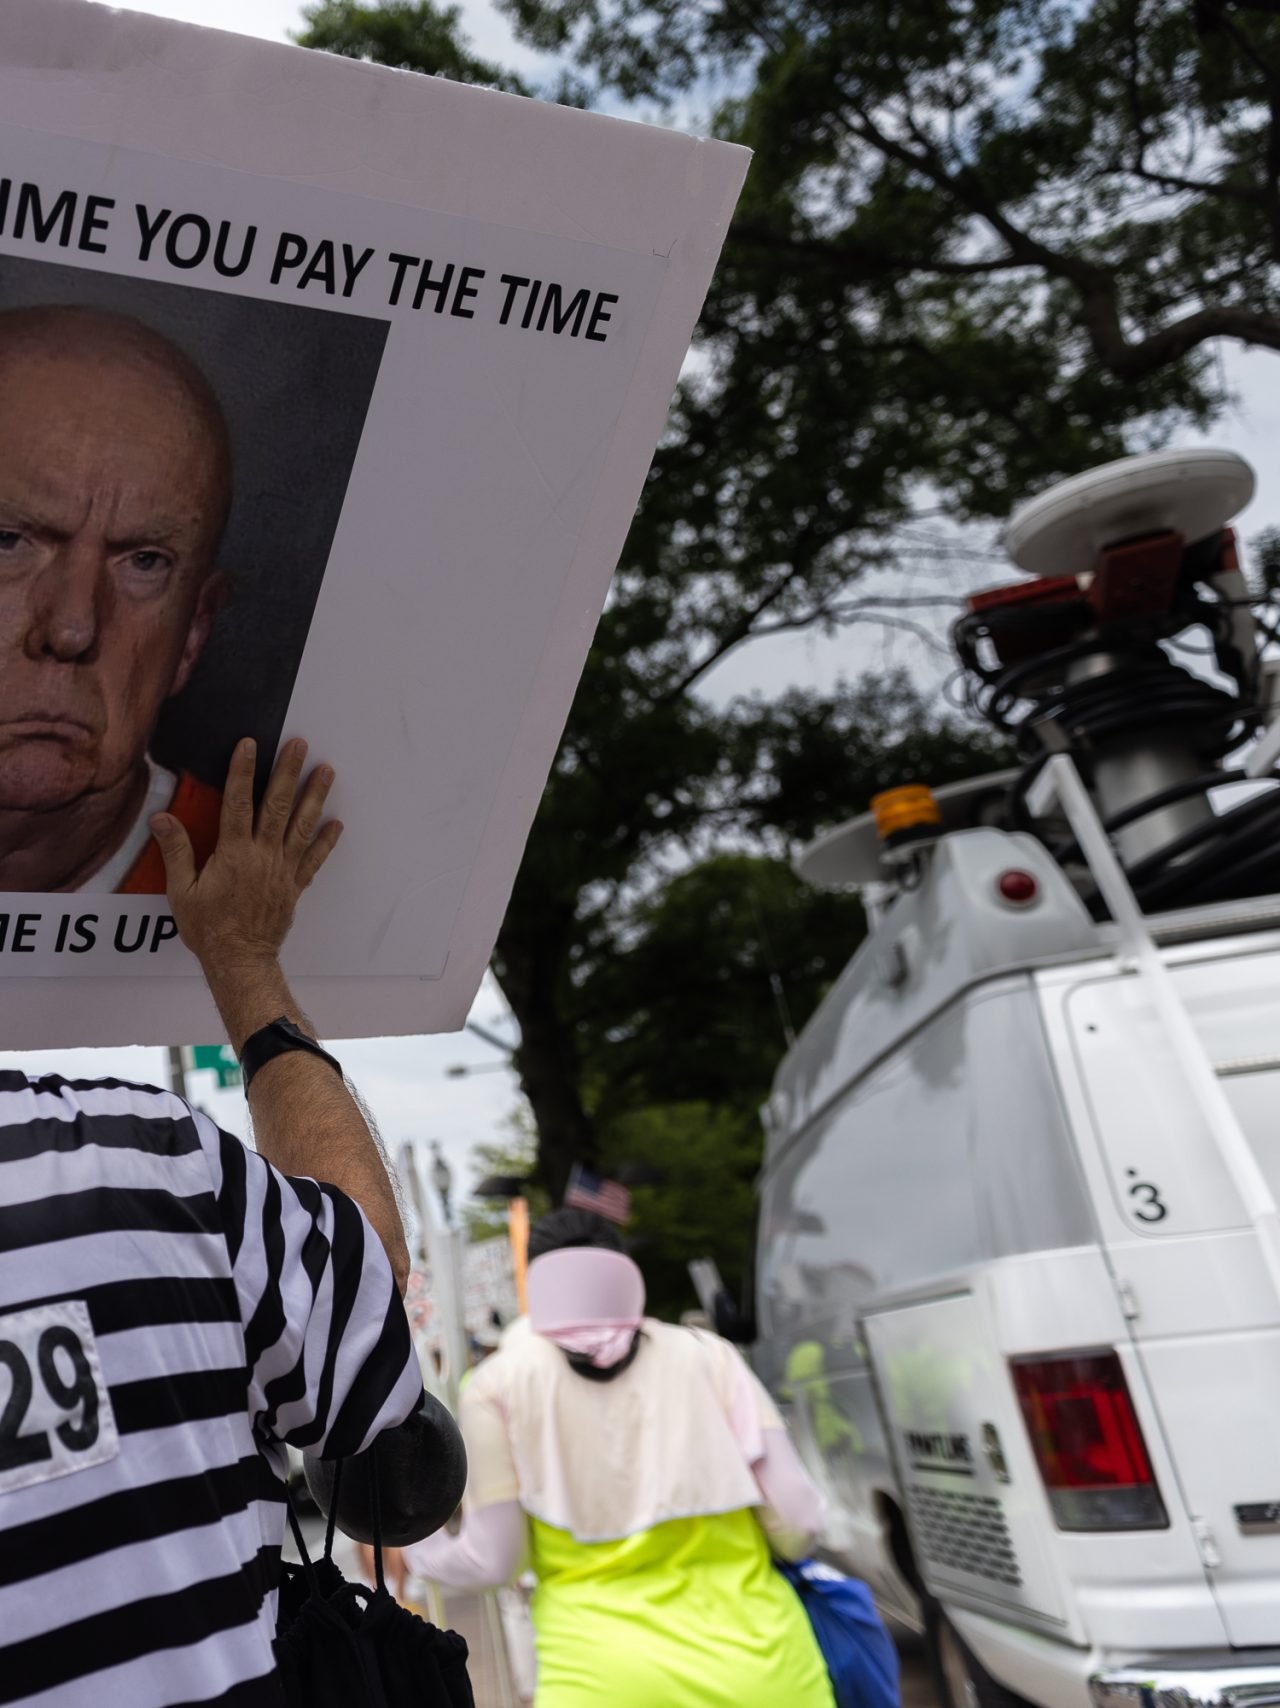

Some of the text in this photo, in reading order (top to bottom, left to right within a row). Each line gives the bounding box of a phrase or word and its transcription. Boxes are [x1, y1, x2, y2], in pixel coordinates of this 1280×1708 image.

[135, 203, 258, 278] YOU
[269, 231, 376, 298] PAY
[387, 252, 486, 319] THE
[498, 273, 619, 343] TIME
[54, 913, 100, 954] IS
[113, 914, 180, 954] UP
[1129, 1183, 1168, 1224] 3
